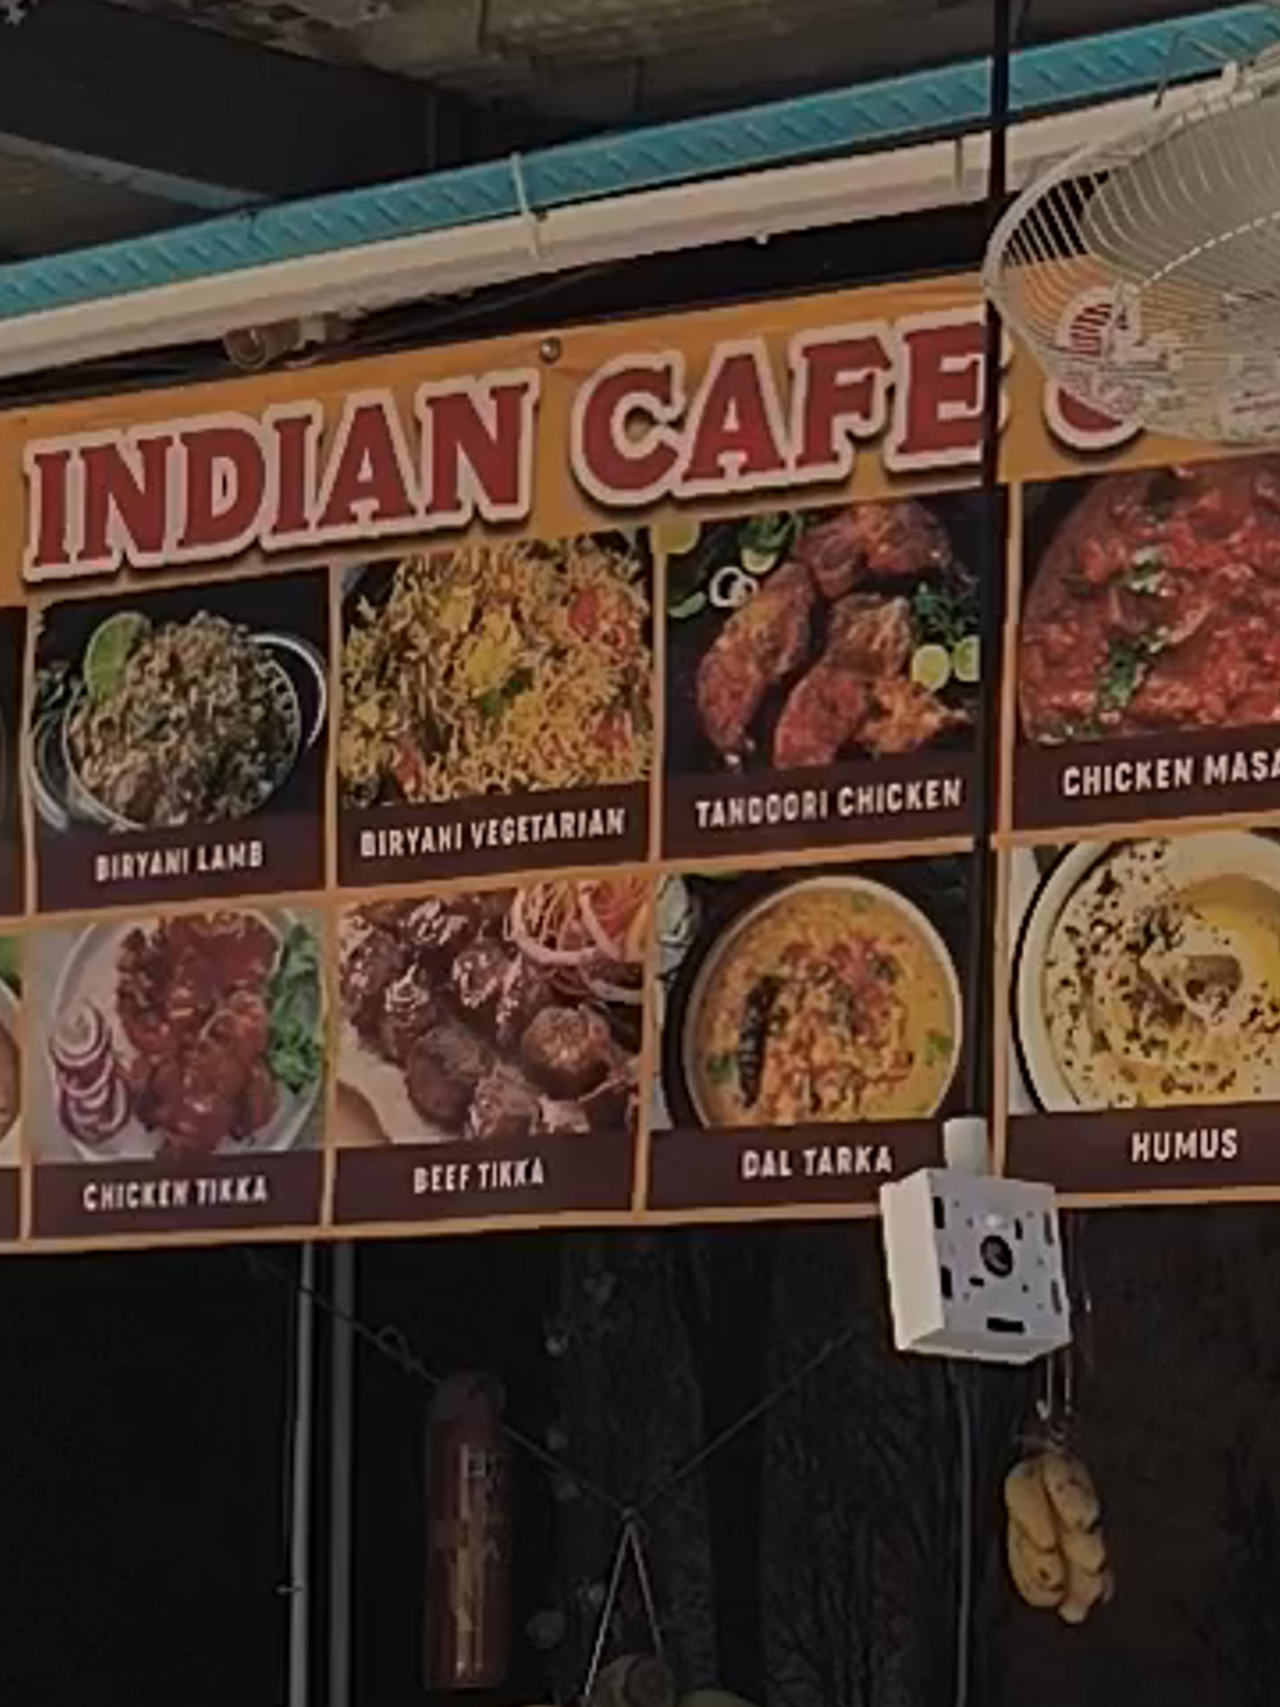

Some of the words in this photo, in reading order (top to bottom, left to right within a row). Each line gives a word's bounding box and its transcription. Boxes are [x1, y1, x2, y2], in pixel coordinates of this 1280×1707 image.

[26, 376, 534, 576] INDIAN
[576, 315, 1000, 499] CAFE
[1062, 757, 1193, 796] CHICKEN
[696, 790, 828, 828] TANDOORI
[838, 778, 962, 816] CHICKEN
[360, 824, 462, 858] BIRYANI
[470, 808, 624, 848] VEGETARIAN
[95, 848, 190, 881] BIRYANI
[196, 841, 263, 873] LAMB
[742, 1150, 792, 1179] DAL
[803, 1145, 892, 1176] TARKA
[1132, 1127, 1238, 1163] HUMUS
[83, 1180, 187, 1211] CHICKEN
[193, 1176, 268, 1206] TIKKA
[414, 1163, 470, 1193] BEEF
[477, 1156, 544, 1189] TIKKA
